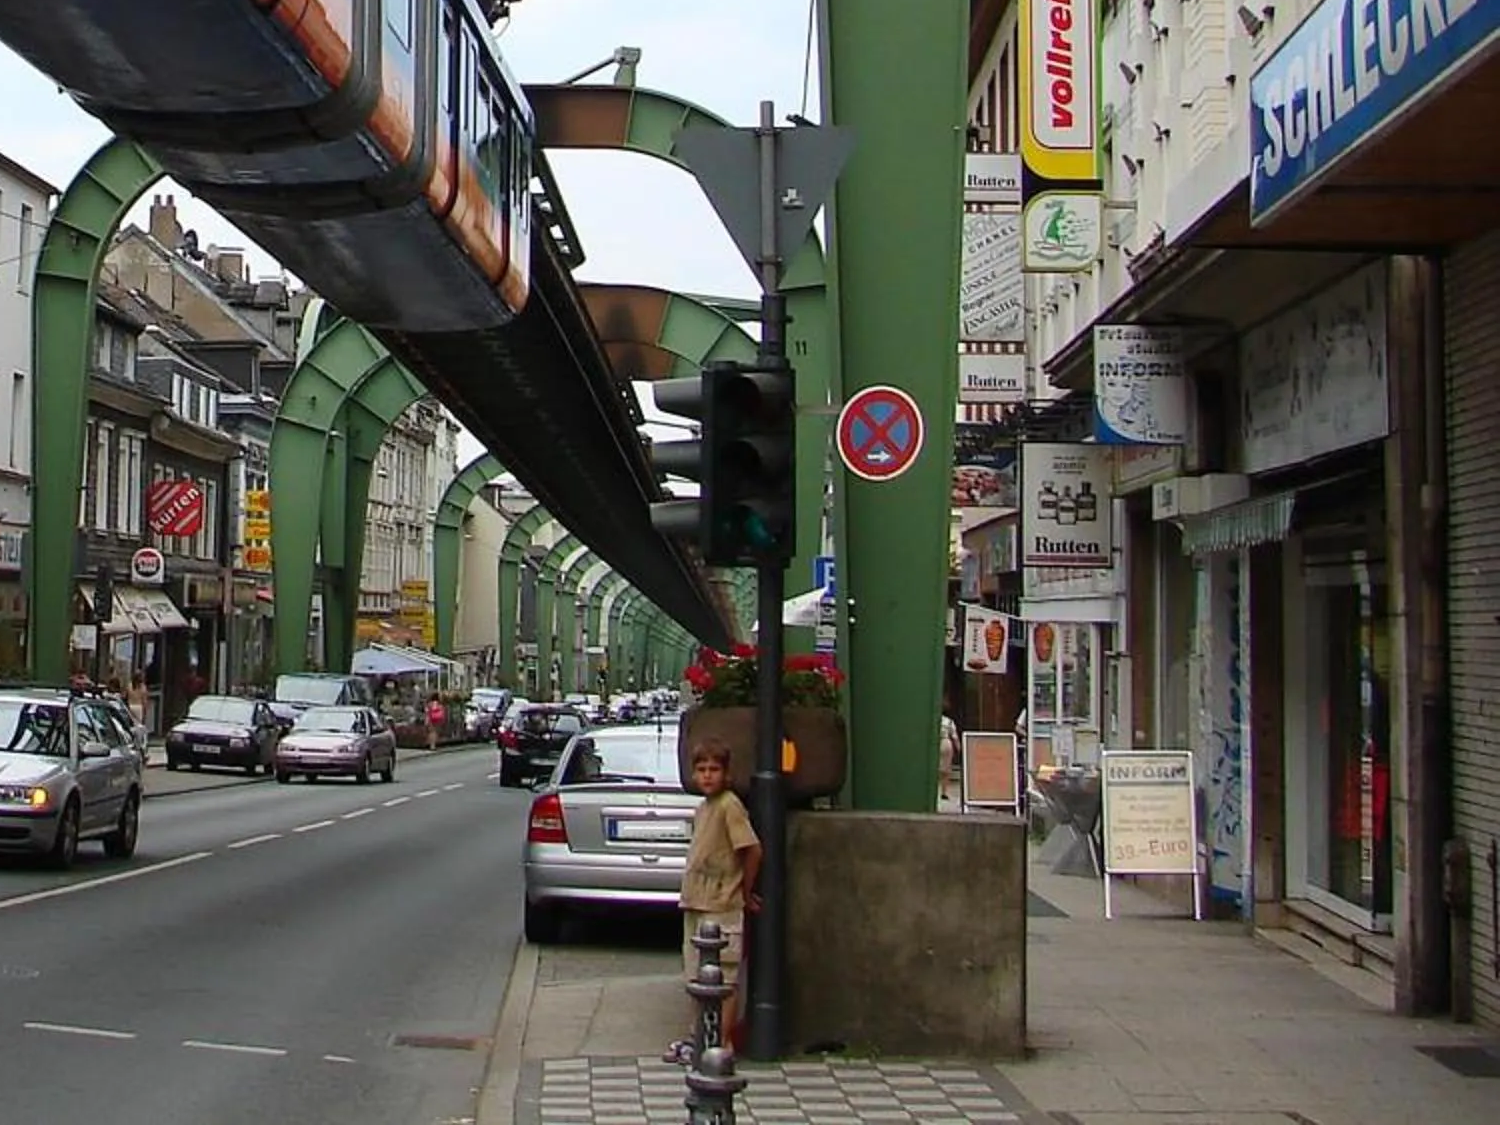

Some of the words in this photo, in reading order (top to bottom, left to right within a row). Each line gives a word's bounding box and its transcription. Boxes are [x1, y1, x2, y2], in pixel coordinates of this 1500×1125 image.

[1099, 361, 1184, 377] INFORM
[1035, 536, 1099, 554] Rutten
[1109, 766, 1187, 779] INFORM
